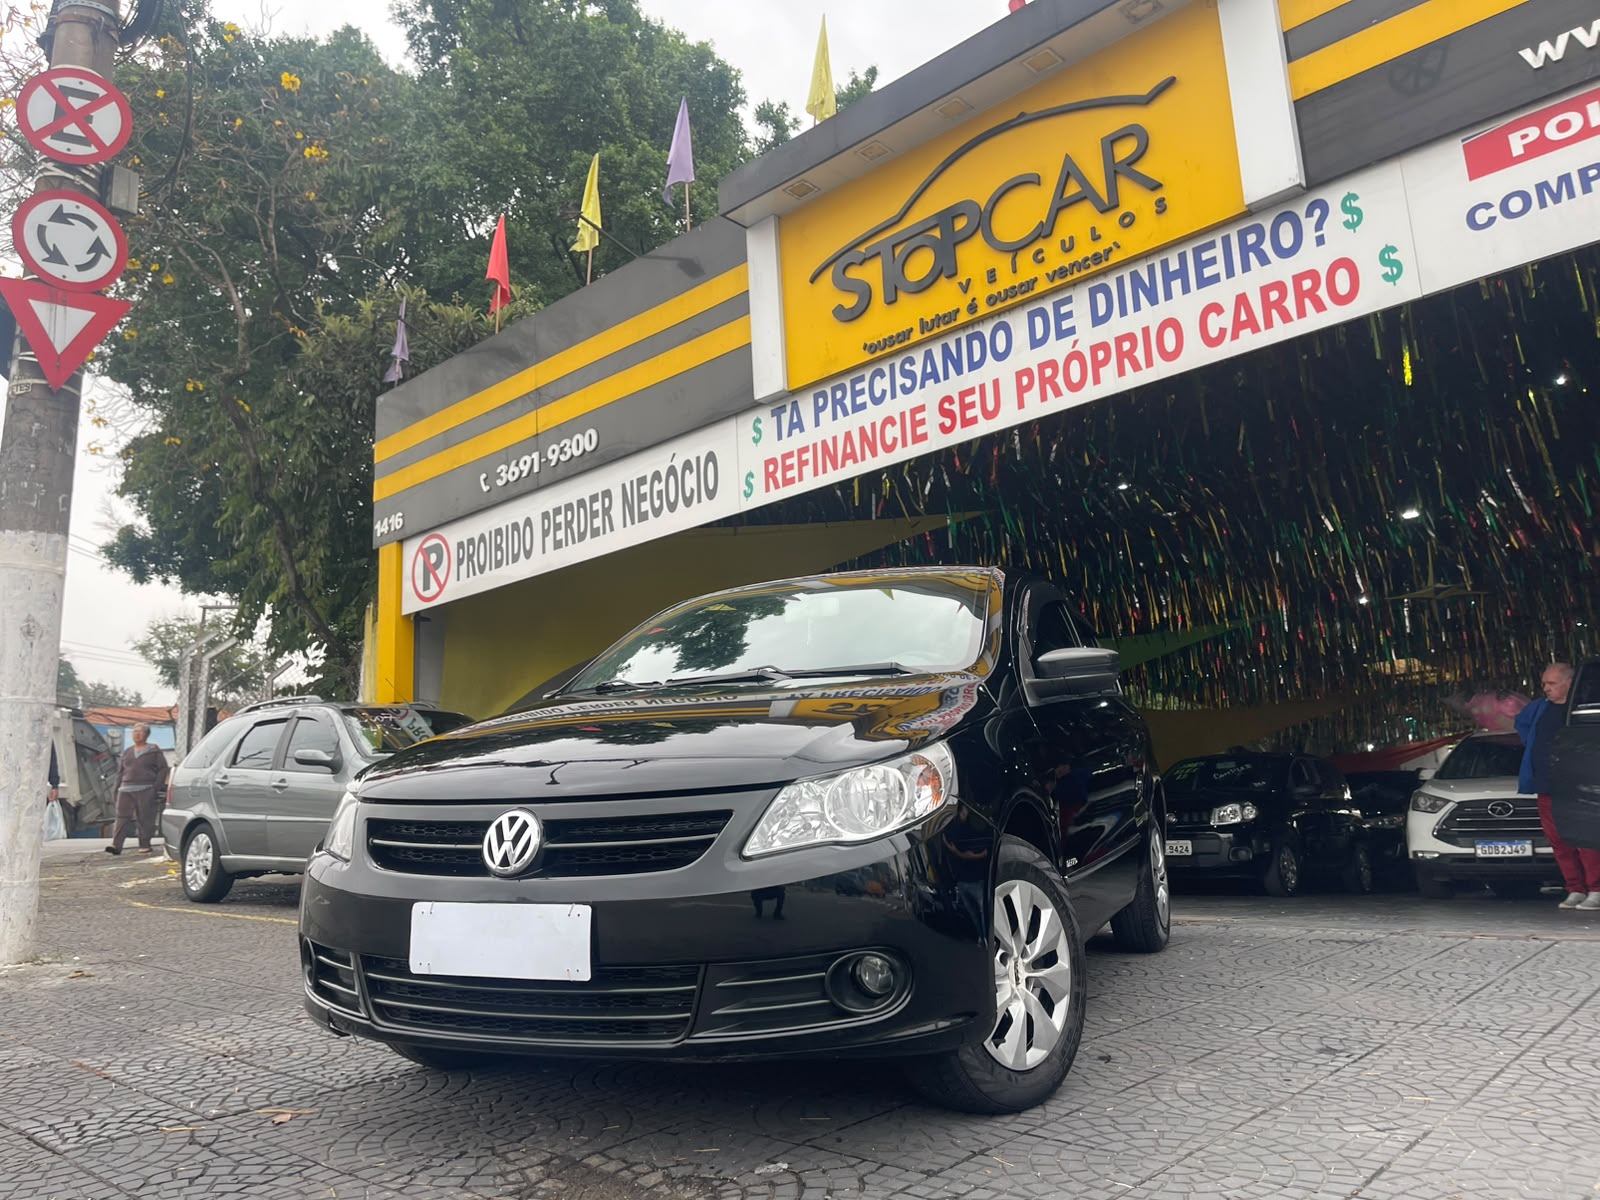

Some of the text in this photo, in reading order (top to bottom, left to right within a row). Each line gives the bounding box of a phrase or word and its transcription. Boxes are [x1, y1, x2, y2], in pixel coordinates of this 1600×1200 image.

[831, 123, 1162, 322] STOPCAR
[771, 400, 805, 441] TA
[813, 321, 1013, 428] PRECISANDO
[1027, 295, 1077, 350] DE
[1088, 198, 1330, 328] DINHEIRO?
[919, 306, 961, 335] lutar
[967, 297, 979, 315] é
[986, 275, 1037, 307] ousar
[764, 404, 928, 493] REFINANCIE
[938, 378, 1001, 435] SEU
[1015, 318, 1184, 411] PRÓPRIO
[1199, 257, 1360, 348] CARRO
[456, 450, 719, 582] PROIBIDO PERDER NEGÓCIO
[496, 428, 598, 487] 3691-9300
[374, 512, 404, 537] 1416
